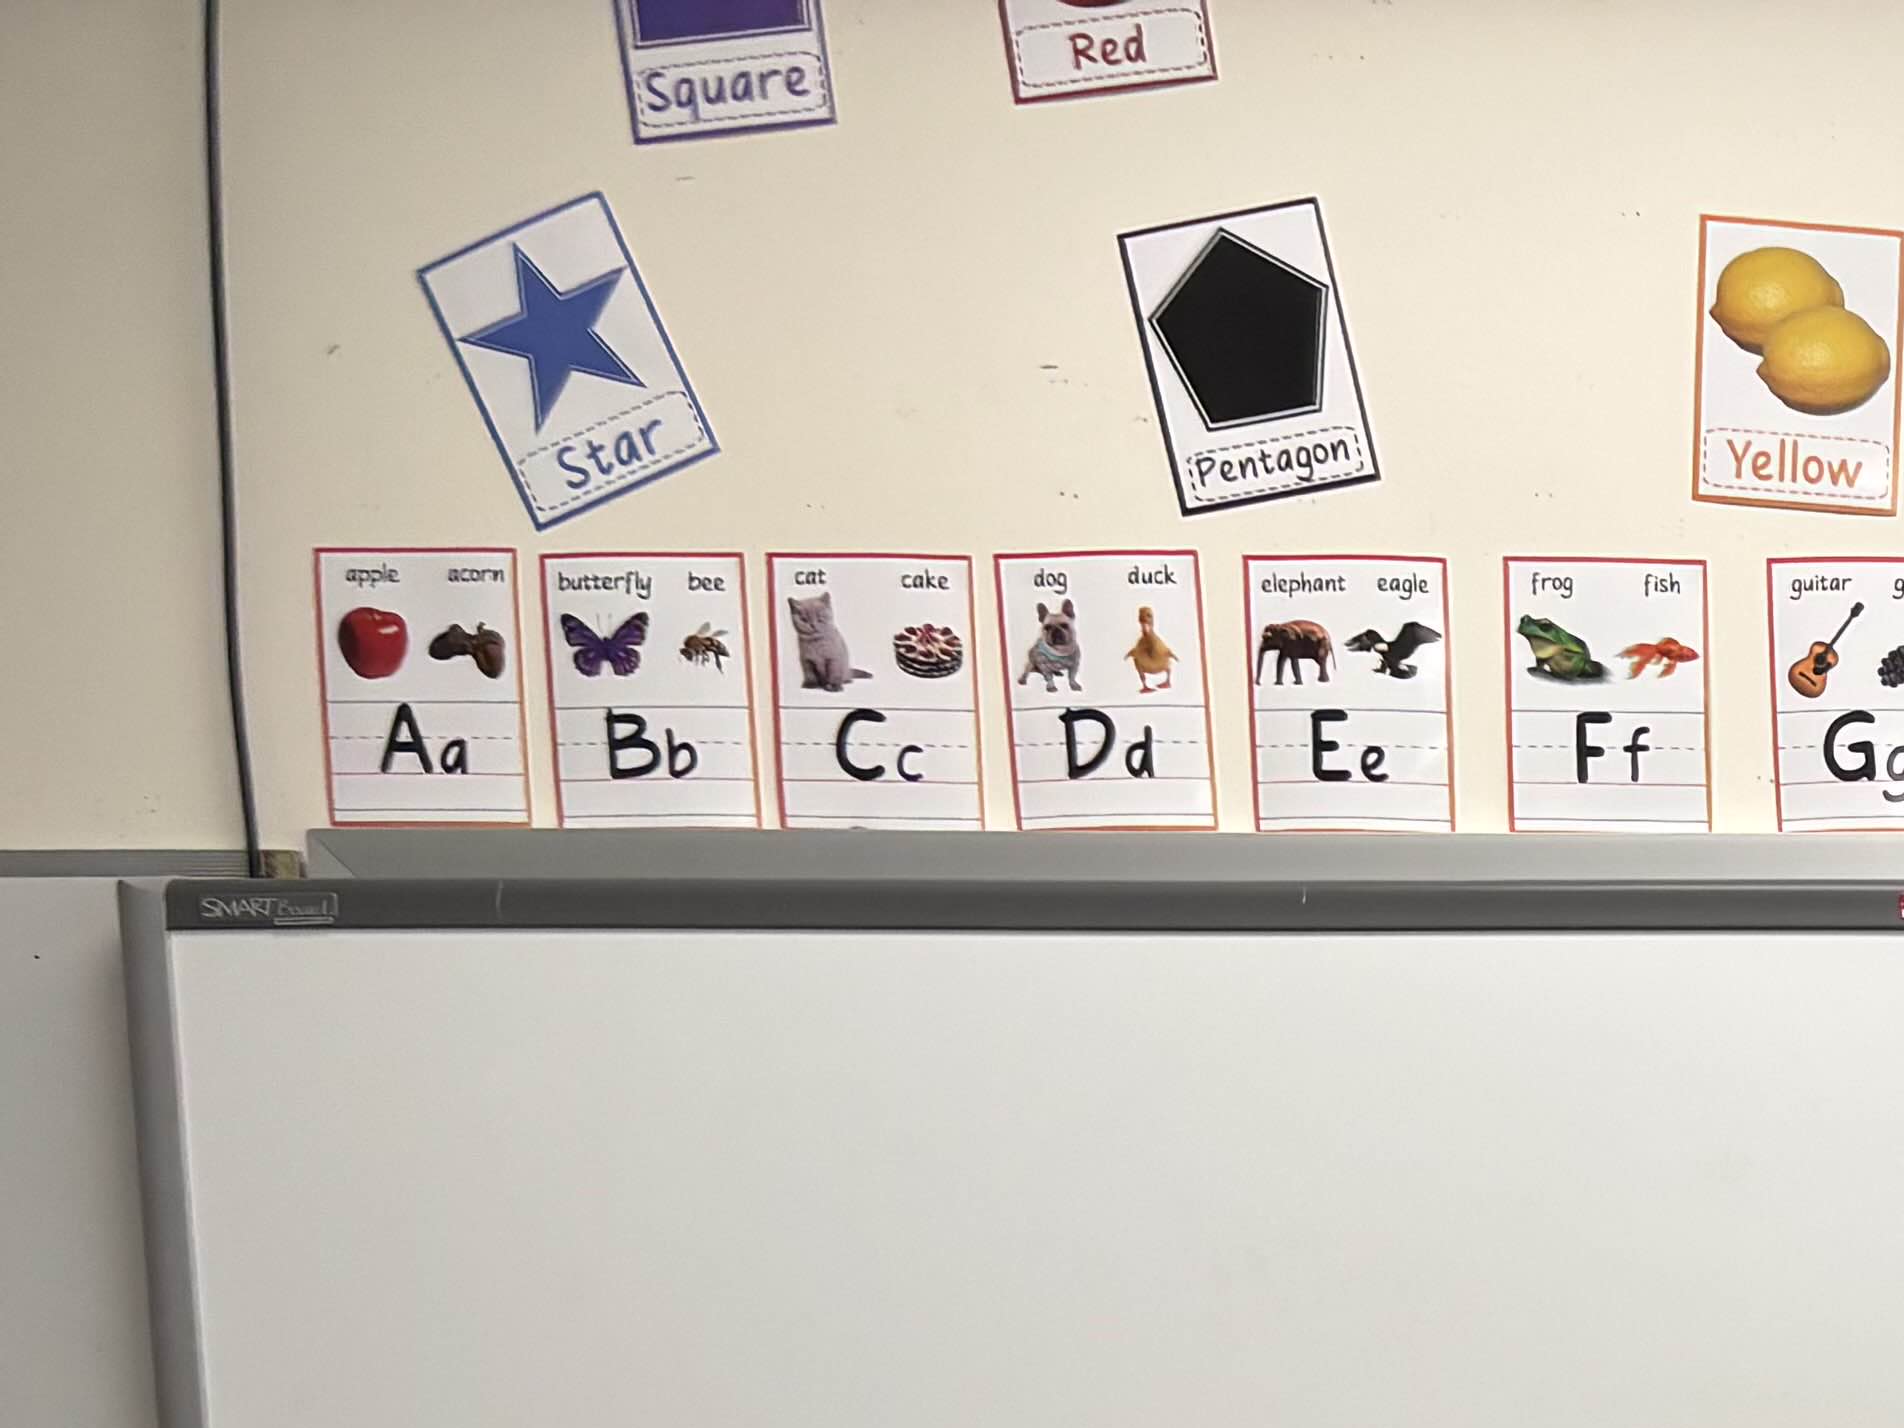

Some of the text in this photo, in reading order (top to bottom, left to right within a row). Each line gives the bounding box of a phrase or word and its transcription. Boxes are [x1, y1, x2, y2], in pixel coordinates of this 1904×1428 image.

[1068, 23, 1146, 70] Red
[642, 58, 811, 122] Square
[556, 419, 664, 490] Star
[1191, 429, 1352, 492] Pentagon
[1725, 438, 1862, 490] Yellow
[345, 563, 505, 588] apple acorn
[558, 571, 725, 600] butterfly bee
[795, 569, 949, 590] cat cake
[1034, 564, 1177, 595] dog duck
[1261, 572, 1429, 600] elephant eagle
[1532, 572, 1680, 599] frog fish
[1790, 575, 1852, 600] guitar
[202, 898, 277, 919] SMART
